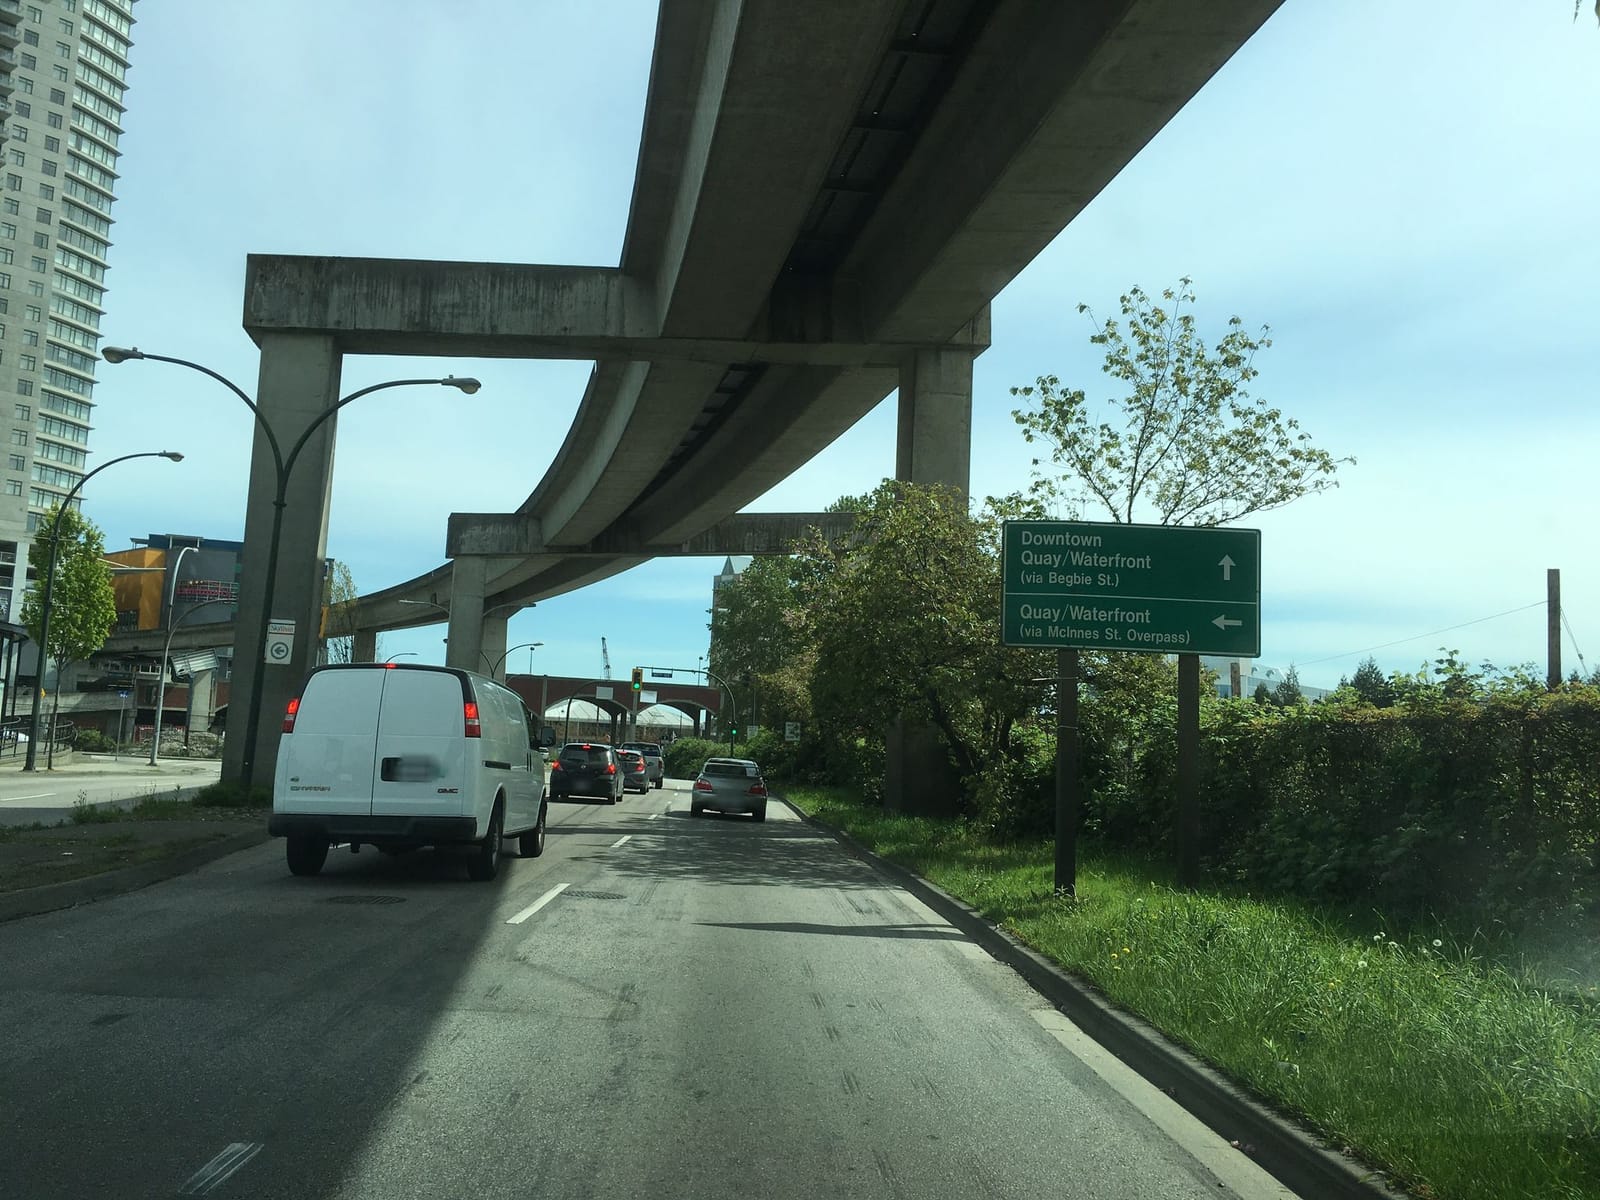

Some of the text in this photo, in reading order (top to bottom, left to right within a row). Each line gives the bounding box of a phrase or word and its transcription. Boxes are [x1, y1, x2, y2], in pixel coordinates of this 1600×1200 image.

[1021, 531, 1102, 548] Downtown
[1021, 549, 1151, 569] Quay/Waterfront
[1020, 571, 1119, 587] (via Begbie St.)
[1020, 604, 1151, 623] Quay/Waterfront
[1019, 623, 1190, 645] (via McInnes St. Overpass)
